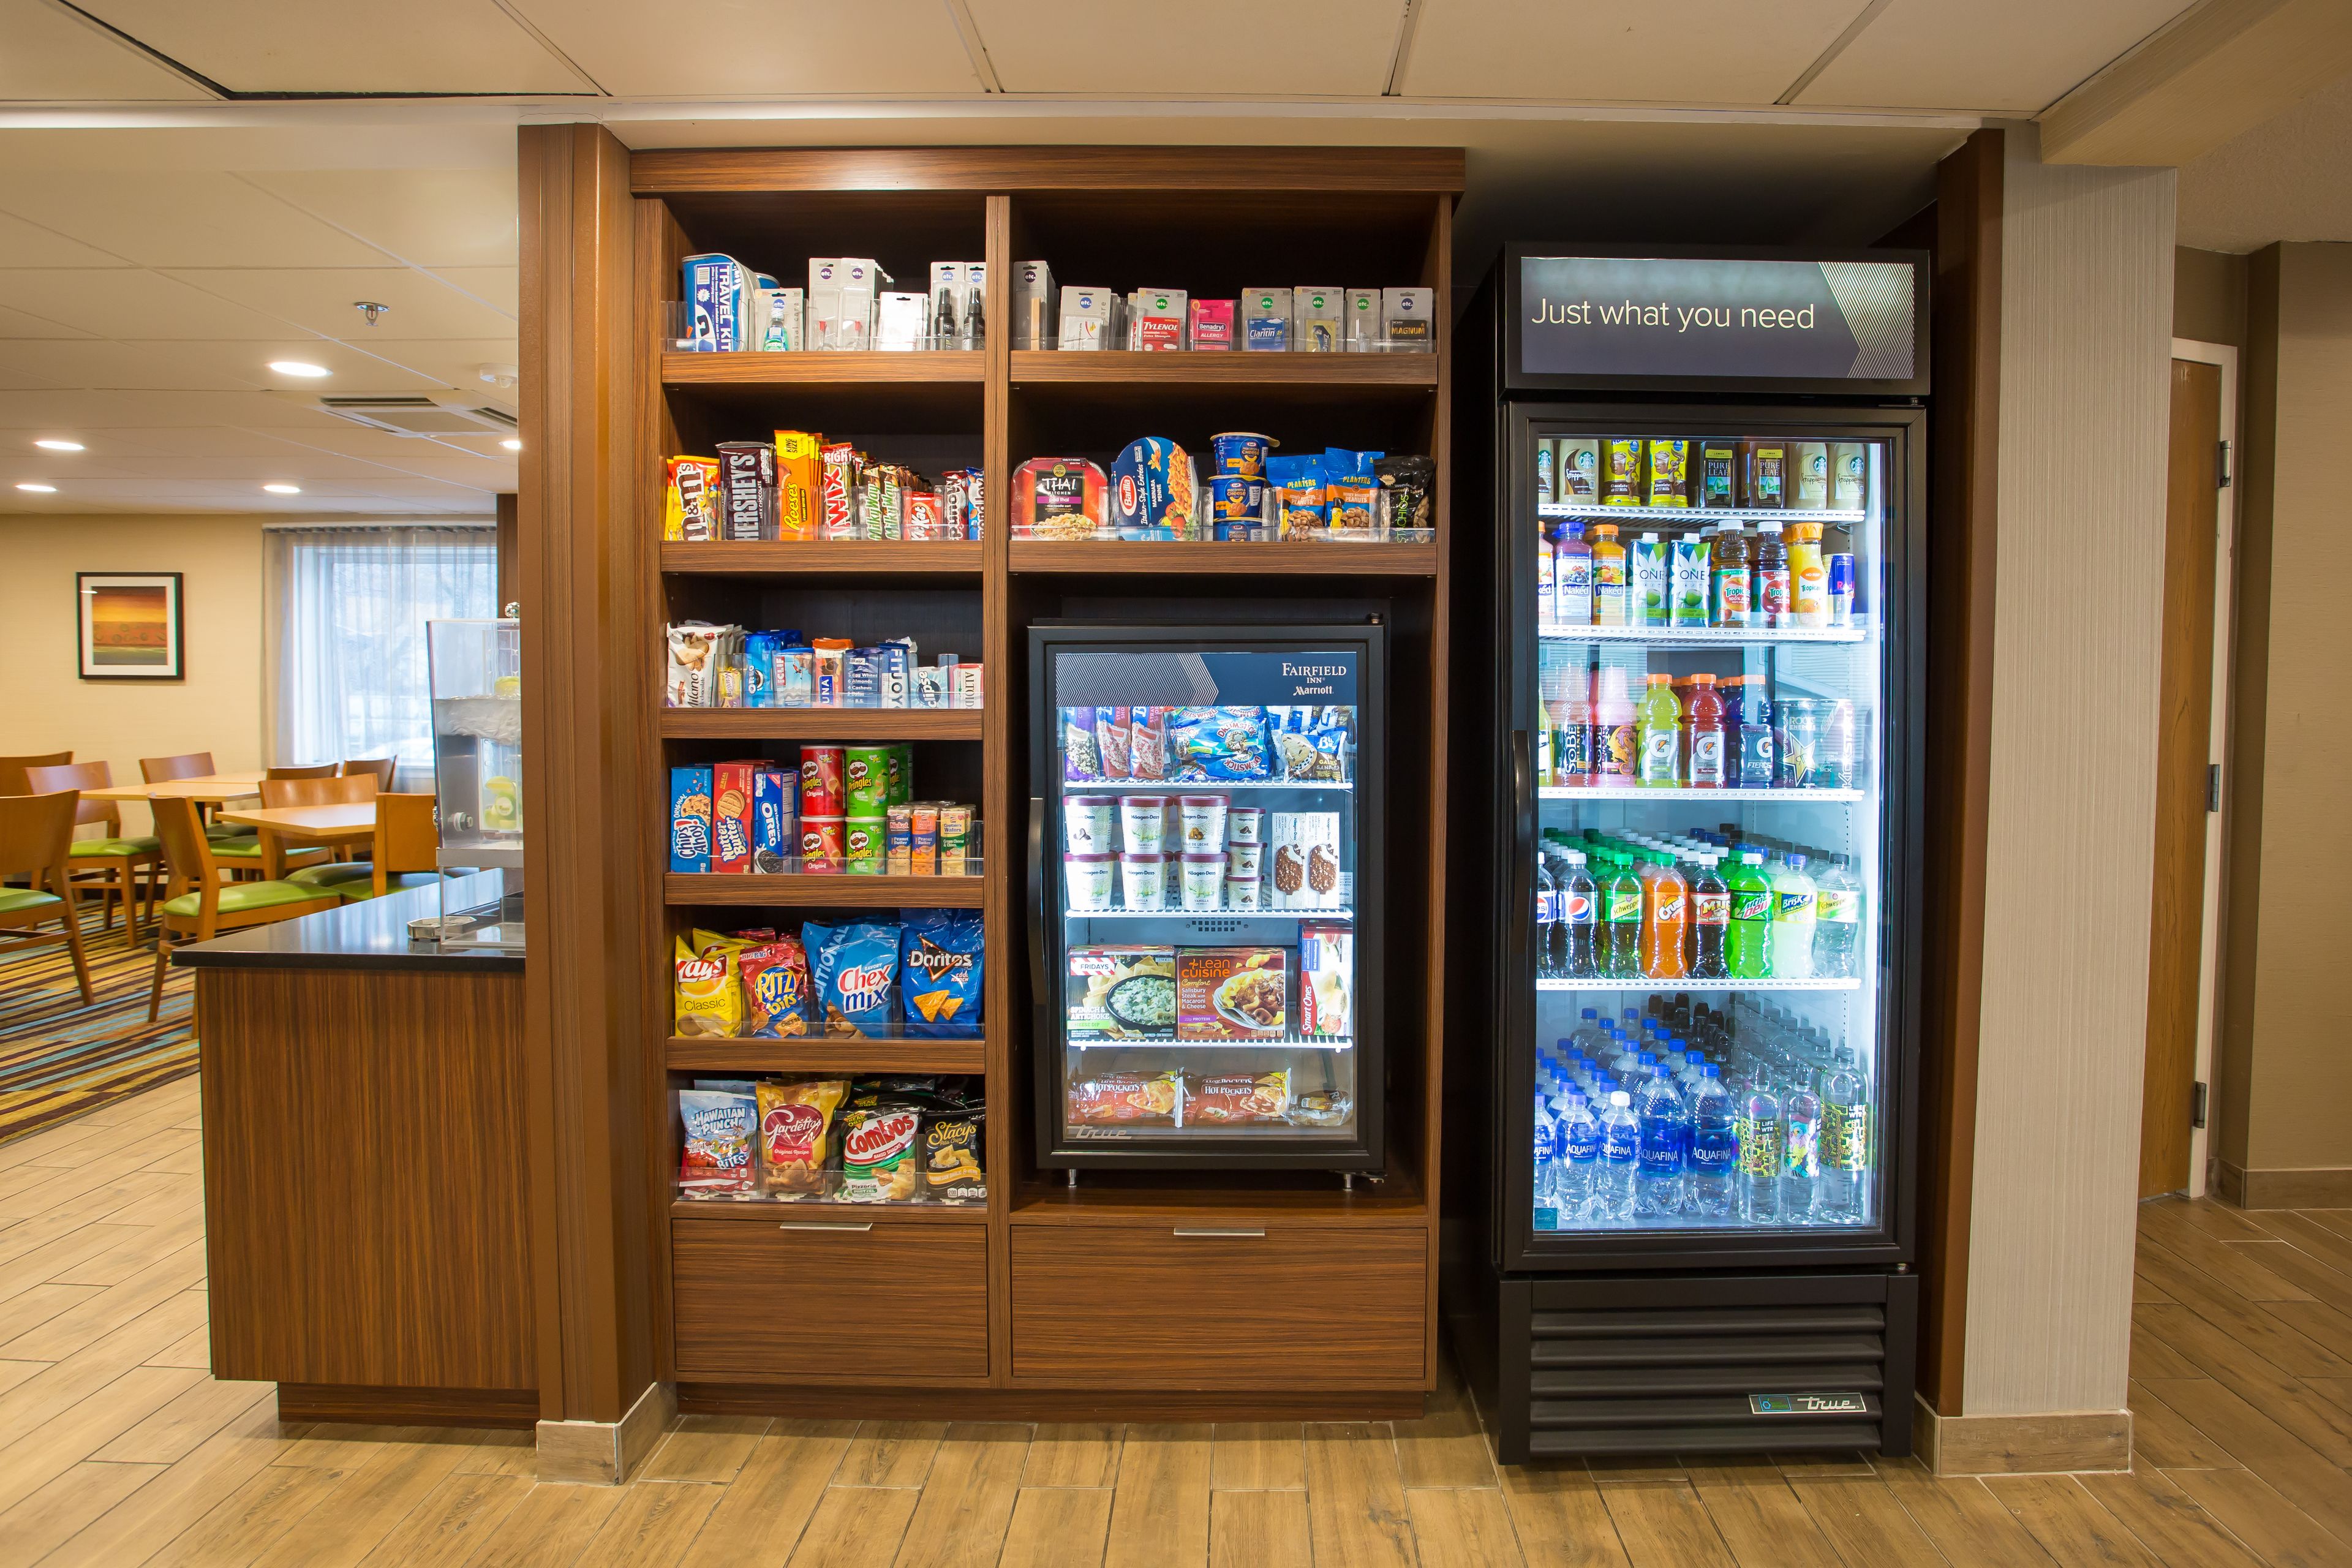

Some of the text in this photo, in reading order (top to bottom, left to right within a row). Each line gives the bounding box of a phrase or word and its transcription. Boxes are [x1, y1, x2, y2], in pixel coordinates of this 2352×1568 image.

[720, 266, 732, 352] TRAVEL KIT
[1531, 298, 1814, 333] Just what you need
[1144, 322, 1178, 331] TYLENOL
[1042, 477, 1076, 491] THAI
[1287, 480, 1316, 489] PLANTERS
[1343, 476, 1371, 484] PLANTERS
[729, 454, 760, 541] HERSHEY'S
[783, 482, 800, 530] Reese's
[1396, 494, 1409, 543] STACHIOS
[1640, 569, 1665, 580] ONE
[1680, 570, 1705, 580] ONE
[1564, 586, 1589, 594] Naked
[1598, 586, 1622, 594] Naked
[1282, 663, 1347, 677] FAIRFIELD
[821, 679, 830, 704] UNA
[918, 671, 938, 708] clipse
[965, 671, 974, 708] ALTOID
[1293, 686, 1333, 696] Marriott
[1217, 722, 1256, 737] DRUMSTICK
[1649, 733, 1671, 758] G
[1696, 735, 1718, 760] G
[848, 777, 872, 795] Pringles
[674, 794, 687, 818] ORIGINAL
[761, 802, 777, 847] OREO
[677, 826, 696, 858] Chips
[717, 821, 736, 862] Nutter
[726, 816, 747, 855] Butter
[848, 847, 872, 866] Pringles
[1613, 900, 1639, 916] Schweppe
[1658, 897, 1686, 921] Crush
[1703, 900, 1730, 914] MUG
[1820, 898, 1846, 911] Schweppe
[814, 925, 850, 1003] DITIONAL
[910, 951, 972, 967] Doritos
[1199, 959, 1230, 968] Lean
[840, 964, 891, 992] Chex
[1182, 968, 1231, 978] cuisine
[758, 971, 795, 1003] RITZ
[684, 998, 726, 1011] Classic
[767, 993, 797, 1016] bits
[845, 984, 888, 1012] mix
[1302, 985, 1313, 1033] Smart Ones
[1094, 1084, 1139, 1092] HOT POCKETS
[695, 1107, 746, 1126] HAWAIIAN
[703, 1118, 742, 1135] PUNCH
[763, 1109, 822, 1149] Gardetto's
[846, 1115, 914, 1155] Combos
[929, 1121, 977, 1145] Stacy's
[1067, 1125, 1132, 1139] true
[873, 1143, 902, 1159] BAKED SNACKS
[1534, 1145, 1553, 1155] AFINA
[1566, 1144, 1597, 1155] AQUAFINA
[1599, 1144, 1632, 1156] AQUAFINA
[1639, 1147, 1679, 1162] AQUAFINA
[1692, 1147, 1732, 1162] AQUAFINA
[1797, 1396, 1856, 1409] true
